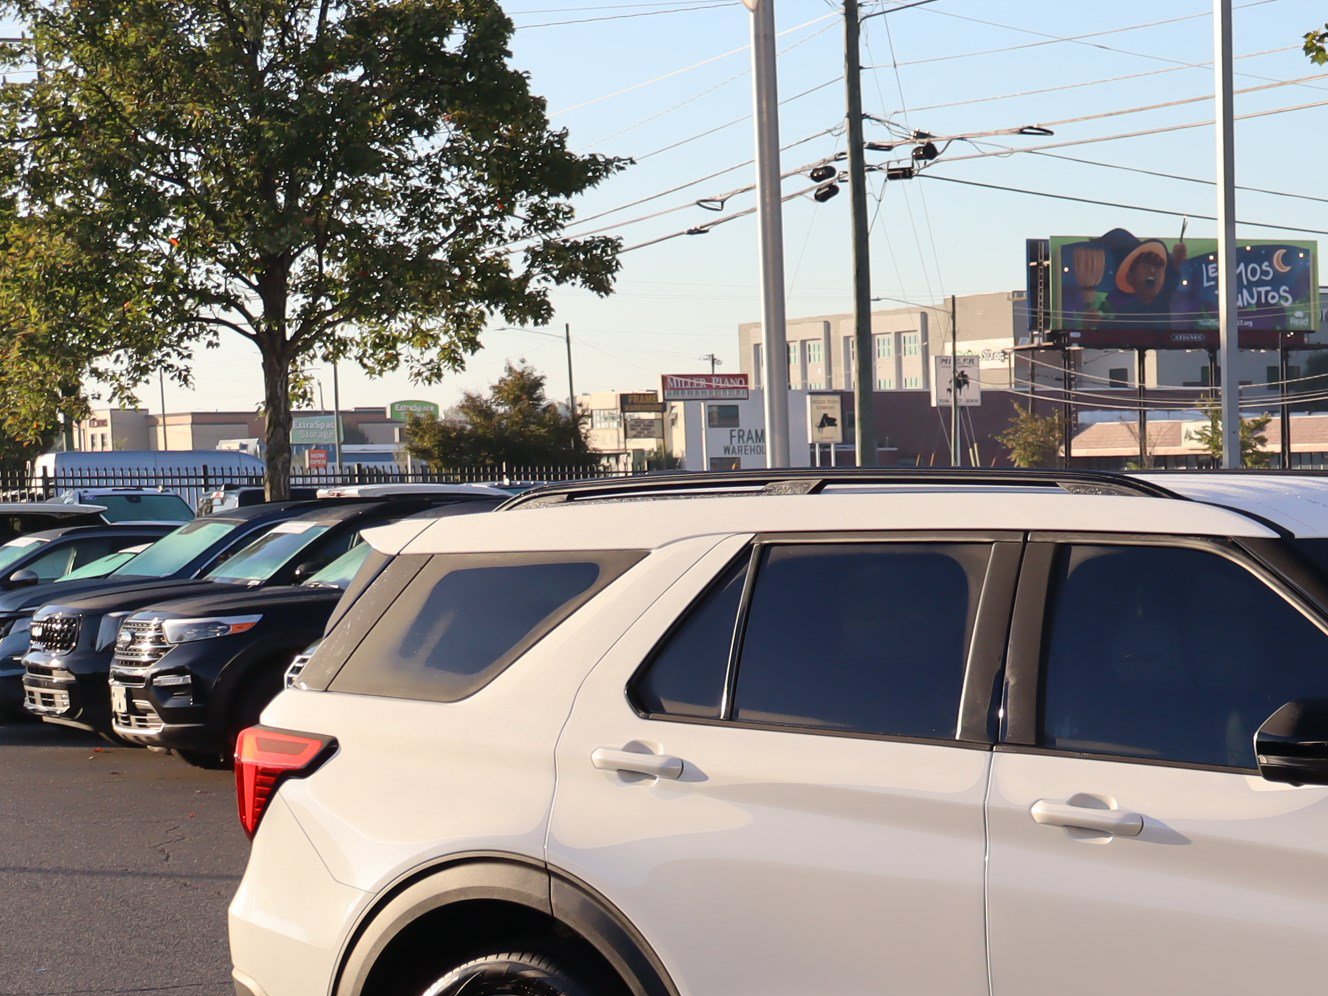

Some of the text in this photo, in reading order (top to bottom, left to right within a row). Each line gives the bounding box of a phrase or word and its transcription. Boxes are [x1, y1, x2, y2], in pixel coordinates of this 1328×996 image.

[667, 376, 745, 389] MILLER PIANO
[293, 419, 337, 430] ExtraSpac
[300, 429, 335, 440] Storage
[730, 428, 765, 445] FRAM
[723, 444, 767, 456] WAREHOU
